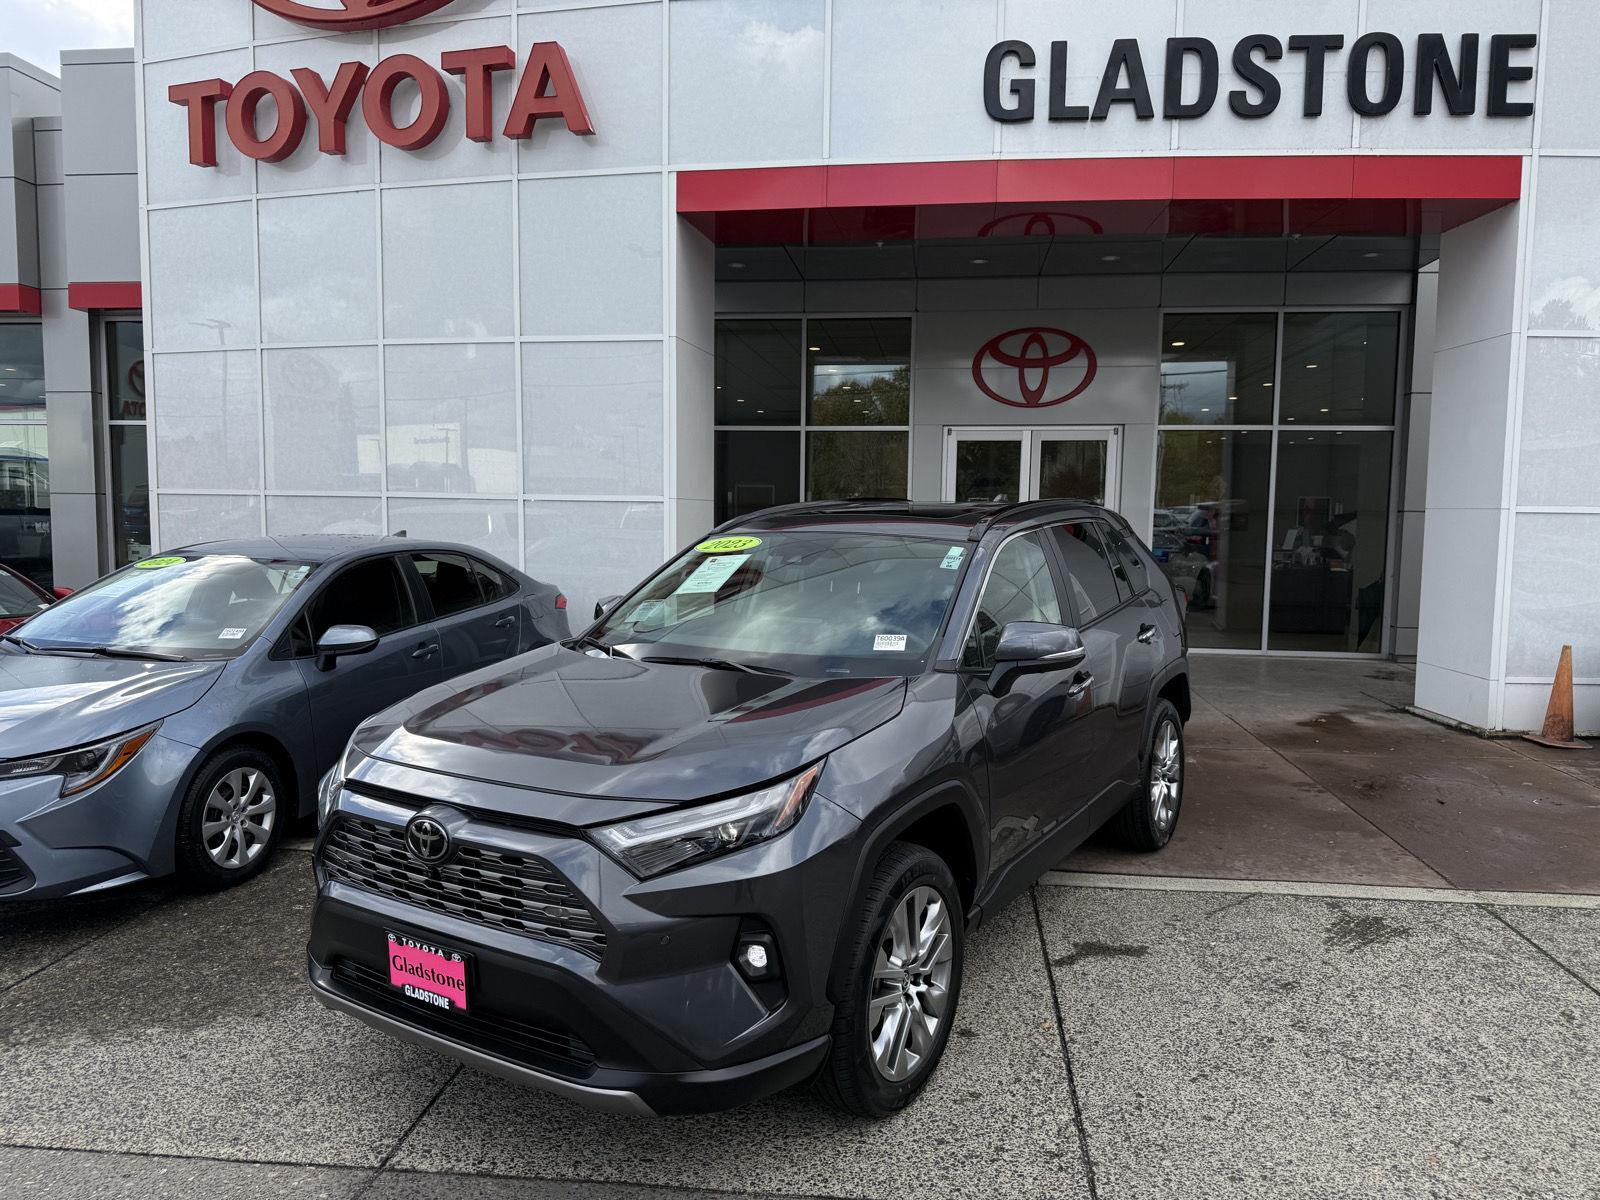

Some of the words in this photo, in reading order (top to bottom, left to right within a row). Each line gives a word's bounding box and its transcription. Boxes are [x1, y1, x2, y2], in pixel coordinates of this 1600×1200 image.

[983, 32, 1537, 122] GLADSTONE
[168, 41, 595, 167] TOYOTA
[701, 539, 754, 550] 2023
[401, 937, 444, 957] TOYOTA
[392, 955, 465, 991] Gladstone
[404, 984, 450, 1010] GLADSTONE
